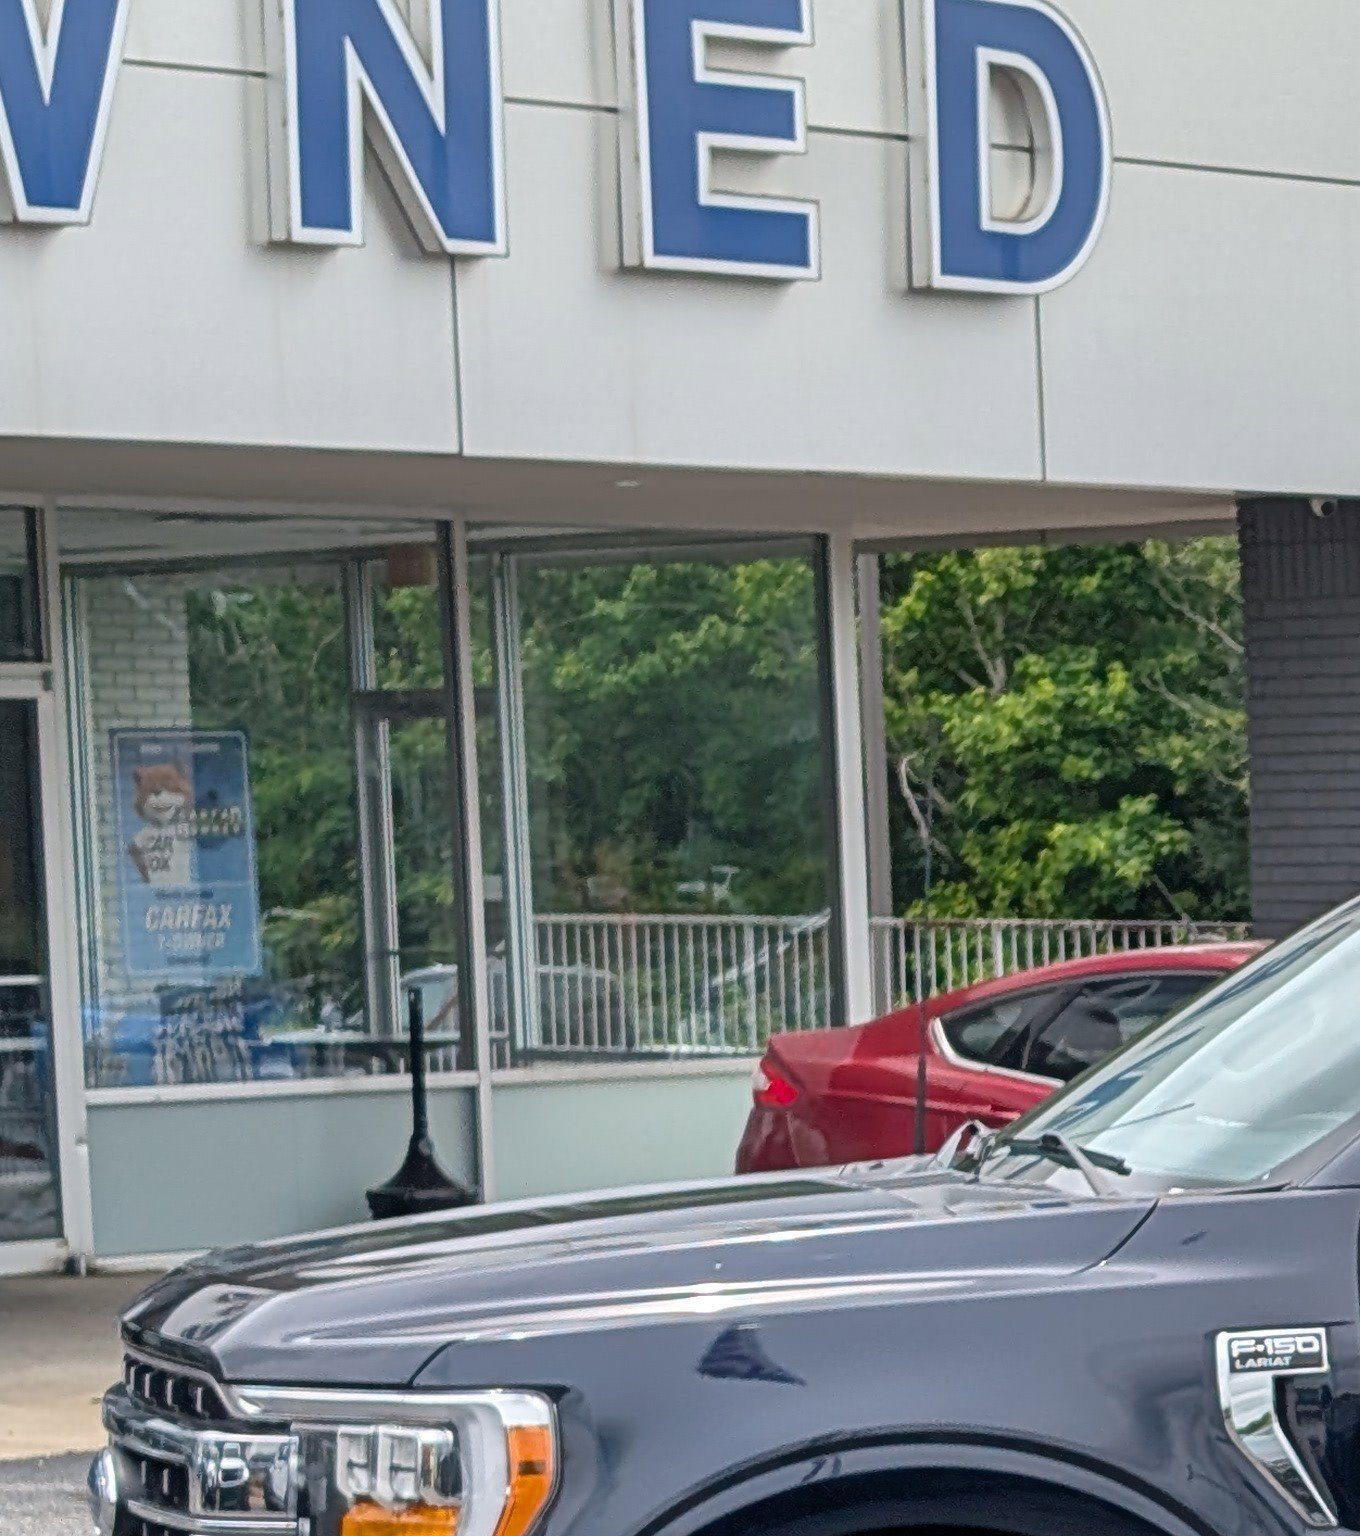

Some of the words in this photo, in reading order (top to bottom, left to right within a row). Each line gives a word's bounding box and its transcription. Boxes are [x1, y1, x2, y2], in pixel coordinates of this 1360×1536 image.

[145, 904, 233, 931] CARFAX
[1231, 1335, 1320, 1358] F-150
[1235, 1356, 1292, 1369] LARIAT
